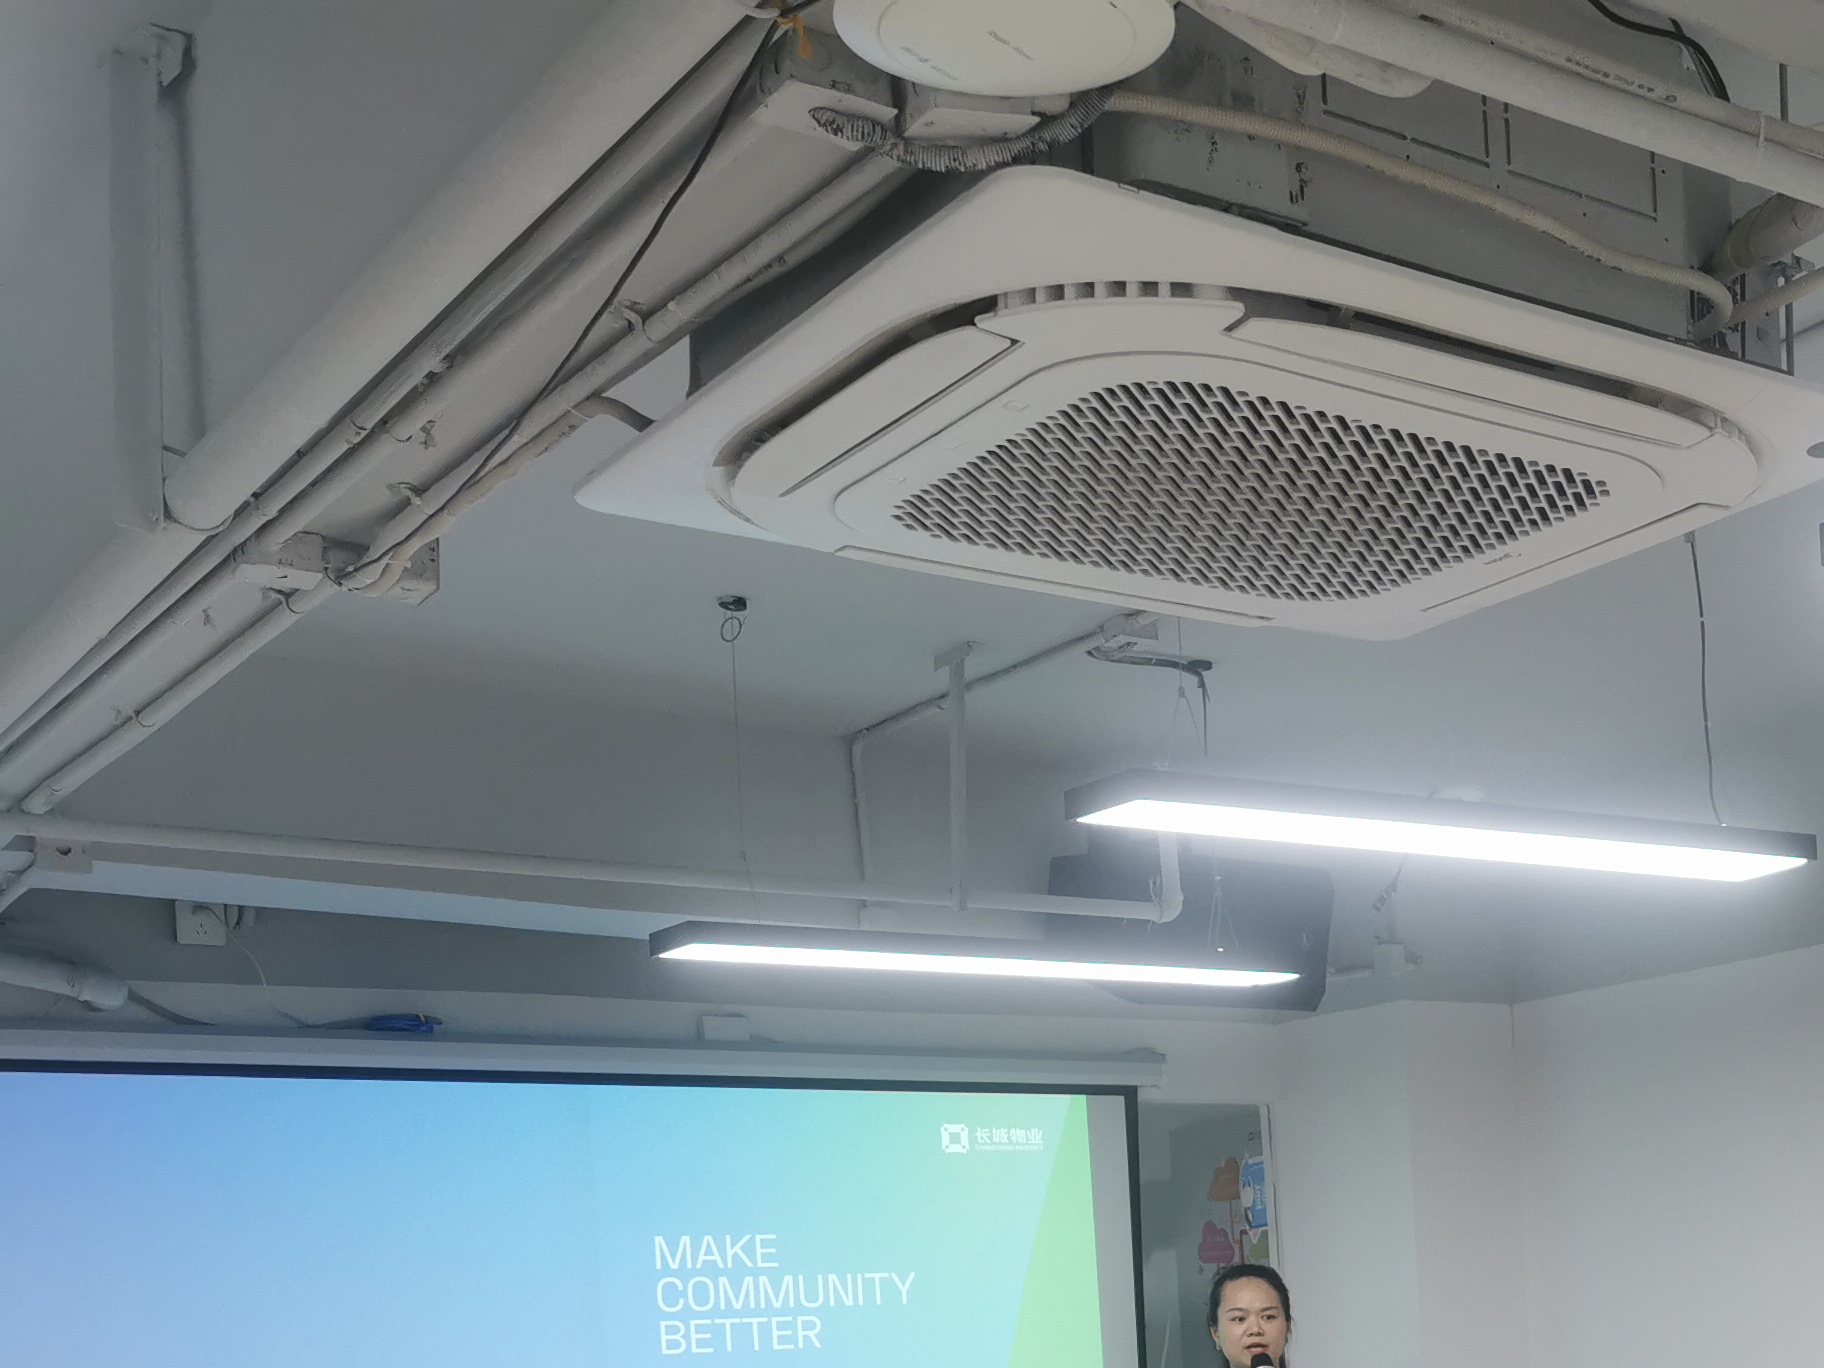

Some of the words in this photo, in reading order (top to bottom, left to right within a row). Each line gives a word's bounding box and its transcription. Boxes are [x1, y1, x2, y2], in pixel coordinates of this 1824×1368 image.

[974, 1127, 1043, 1144] 长城物业
[654, 1234, 779, 1270] MAKE
[656, 1272, 916, 1313] COMMUNITY
[659, 1315, 822, 1355] BETTER
